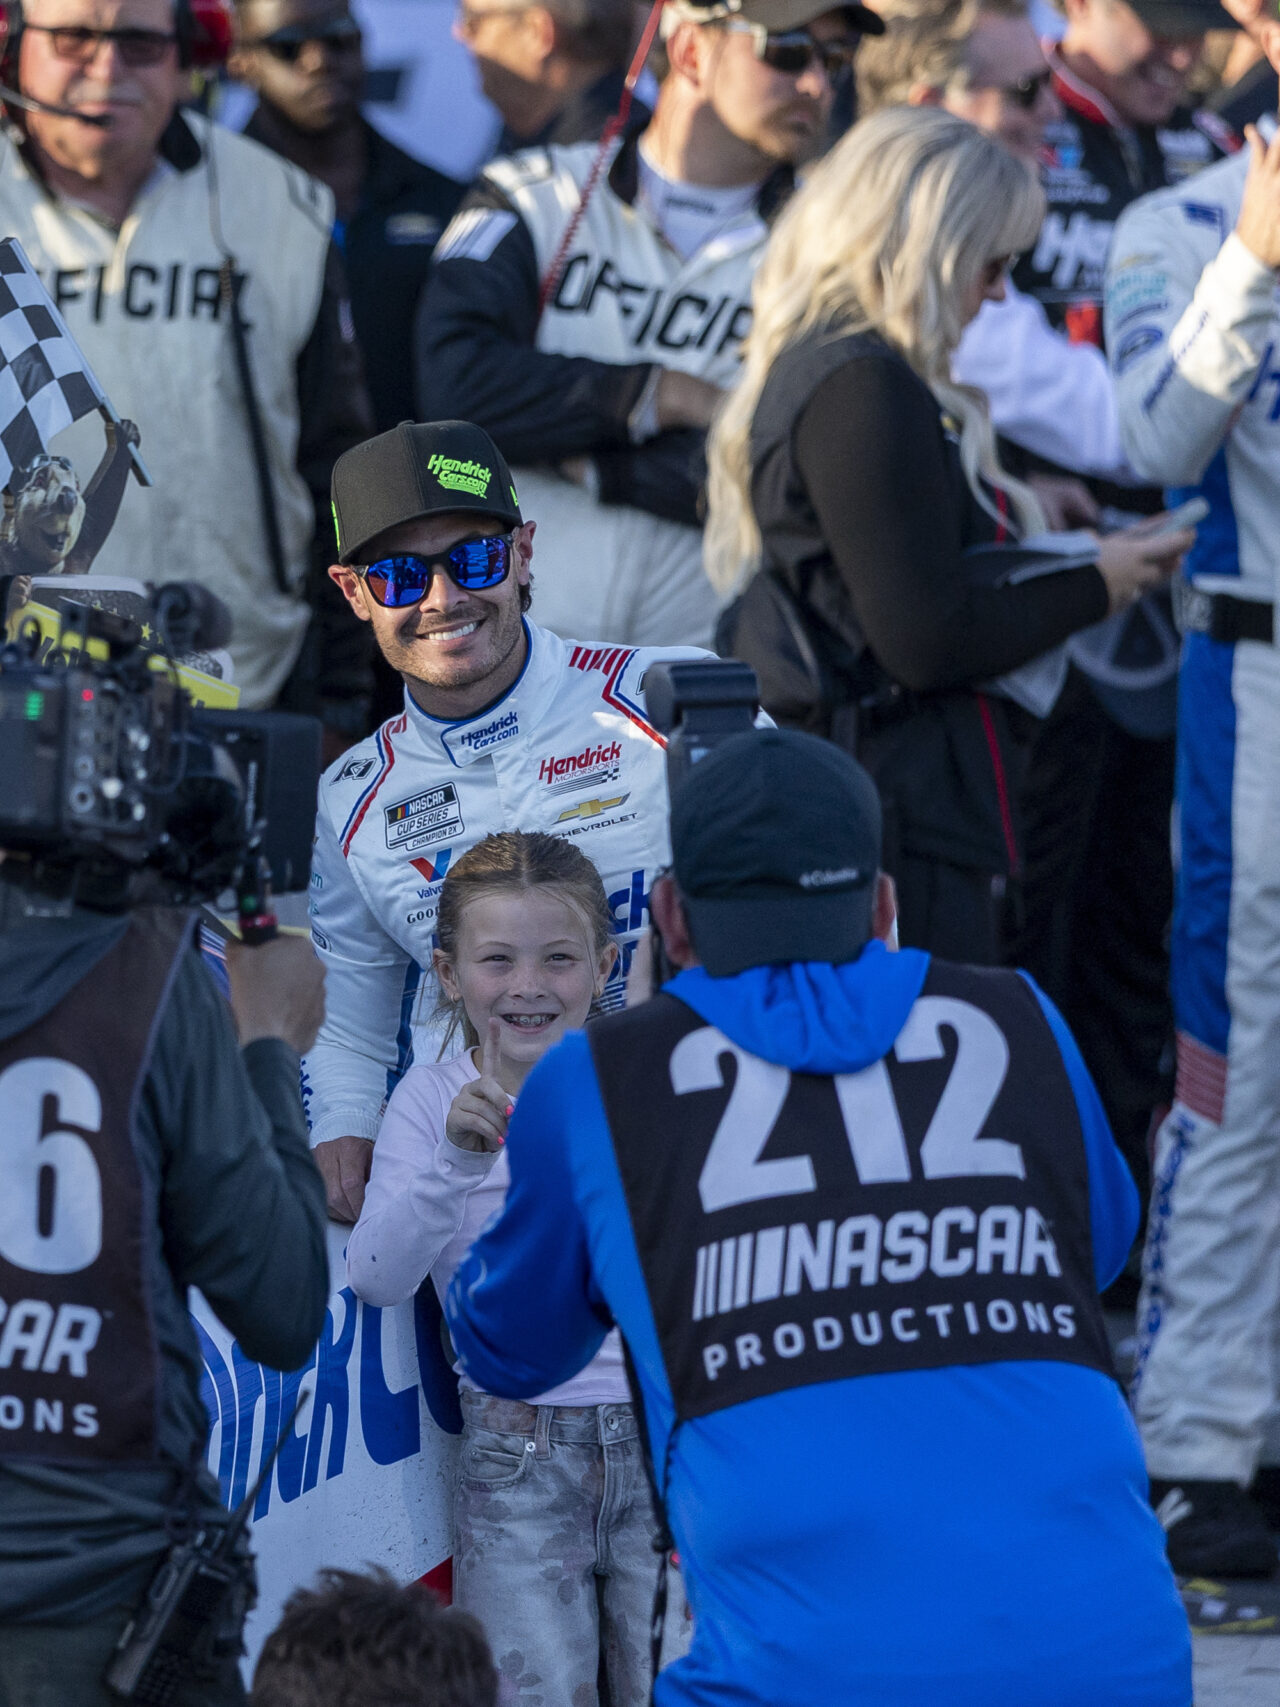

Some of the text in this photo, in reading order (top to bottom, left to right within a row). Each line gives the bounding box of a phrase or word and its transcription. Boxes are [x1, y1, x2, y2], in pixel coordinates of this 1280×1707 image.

[427, 454, 492, 483] Hendrick
[439, 470, 487, 495] Cars.com
[461, 712, 518, 746] Hendrick
[473, 725, 519, 750] Cars.com
[538, 741, 622, 784] Hendrick
[554, 760, 621, 783] MOTORSPORTS
[409, 790, 445, 815] NASCAR
[397, 808, 449, 836] CUP SERIES
[412, 825, 457, 847] CHAMPION 2X
[555, 812, 637, 839] HEVROLET
[669, 995, 1026, 1213] 212
[783, 1205, 1062, 1296] NASCAR
[702, 1300, 1076, 1381] PRODUCTIONS
